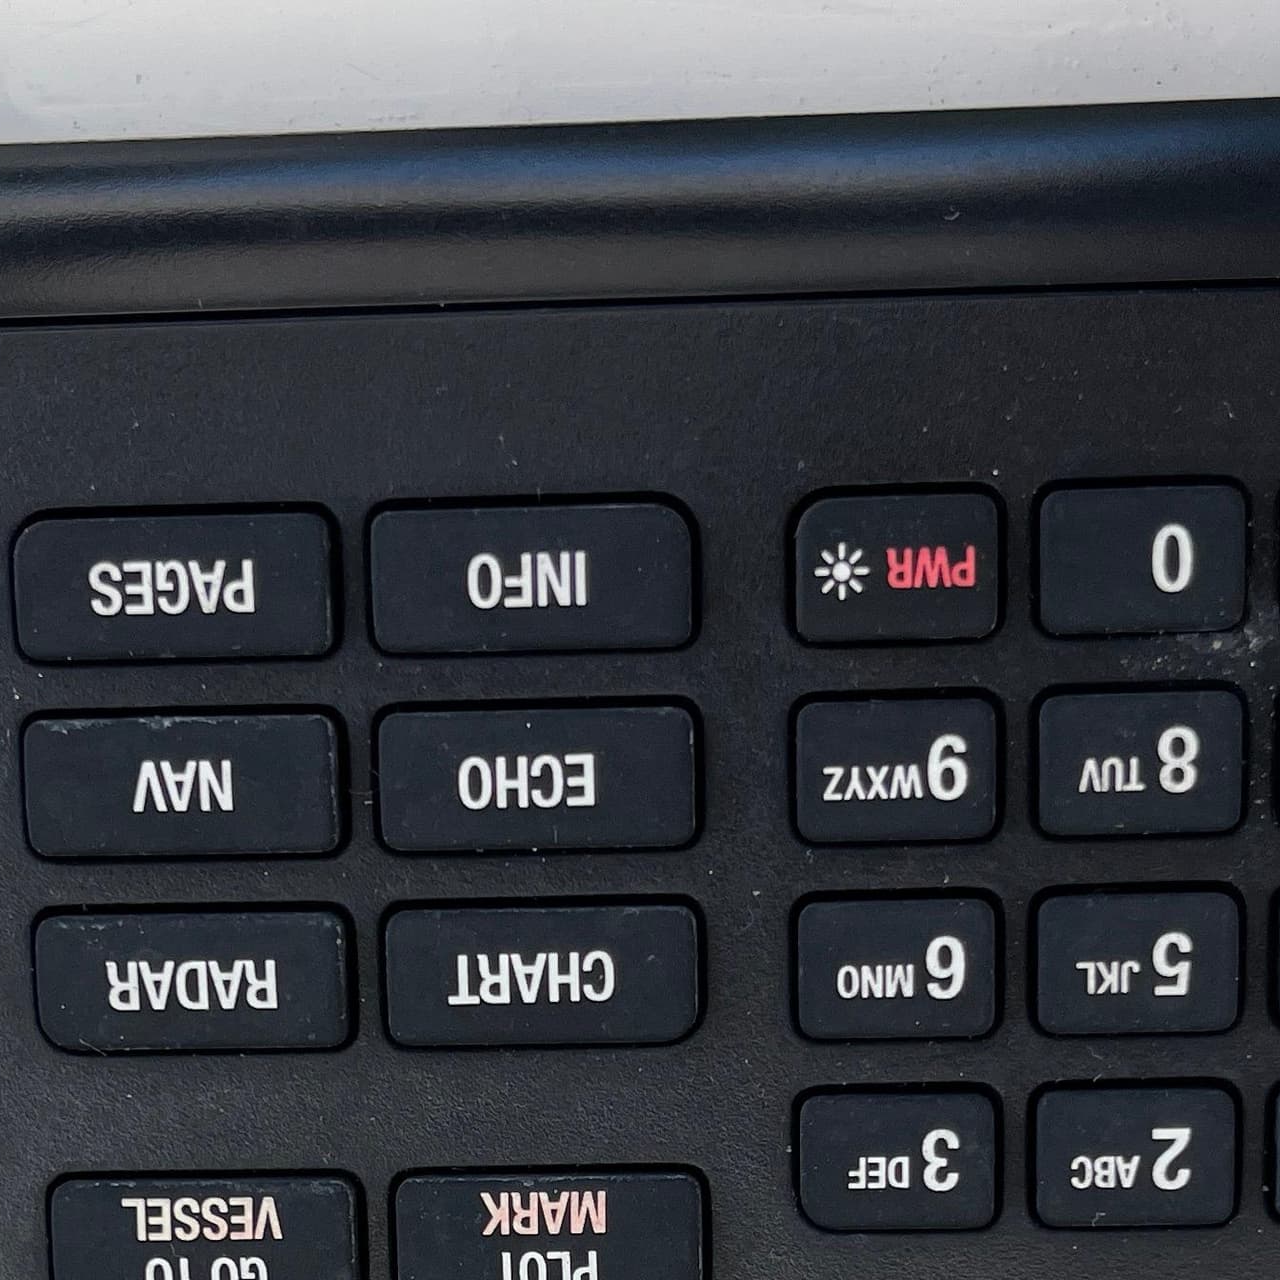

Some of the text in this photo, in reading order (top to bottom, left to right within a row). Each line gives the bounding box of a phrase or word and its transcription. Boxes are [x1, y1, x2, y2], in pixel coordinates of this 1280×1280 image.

[467, 550, 587, 609] INFO
[885, 545, 977, 588] PWR
[1151, 523, 1194, 593] 0
[88, 559, 255, 616] PAGES
[132, 759, 234, 813] NAV
[458, 753, 596, 810] ECHO
[822, 734, 969, 801] 9 WXYZ
[1078, 726, 1199, 793] 8 TUV
[105, 959, 278, 1011] RADAR
[447, 950, 615, 1006] CHART
[837, 935, 966, 1000] 6 MNO
[1075, 931, 1193, 996] 5 JKL
[847, 1128, 960, 1192] 3 DEF
[1070, 1127, 1192, 1190] 2 ABC
[121, 1196, 283, 1242] VESSEL
[480, 1190, 607, 1236] MARK
